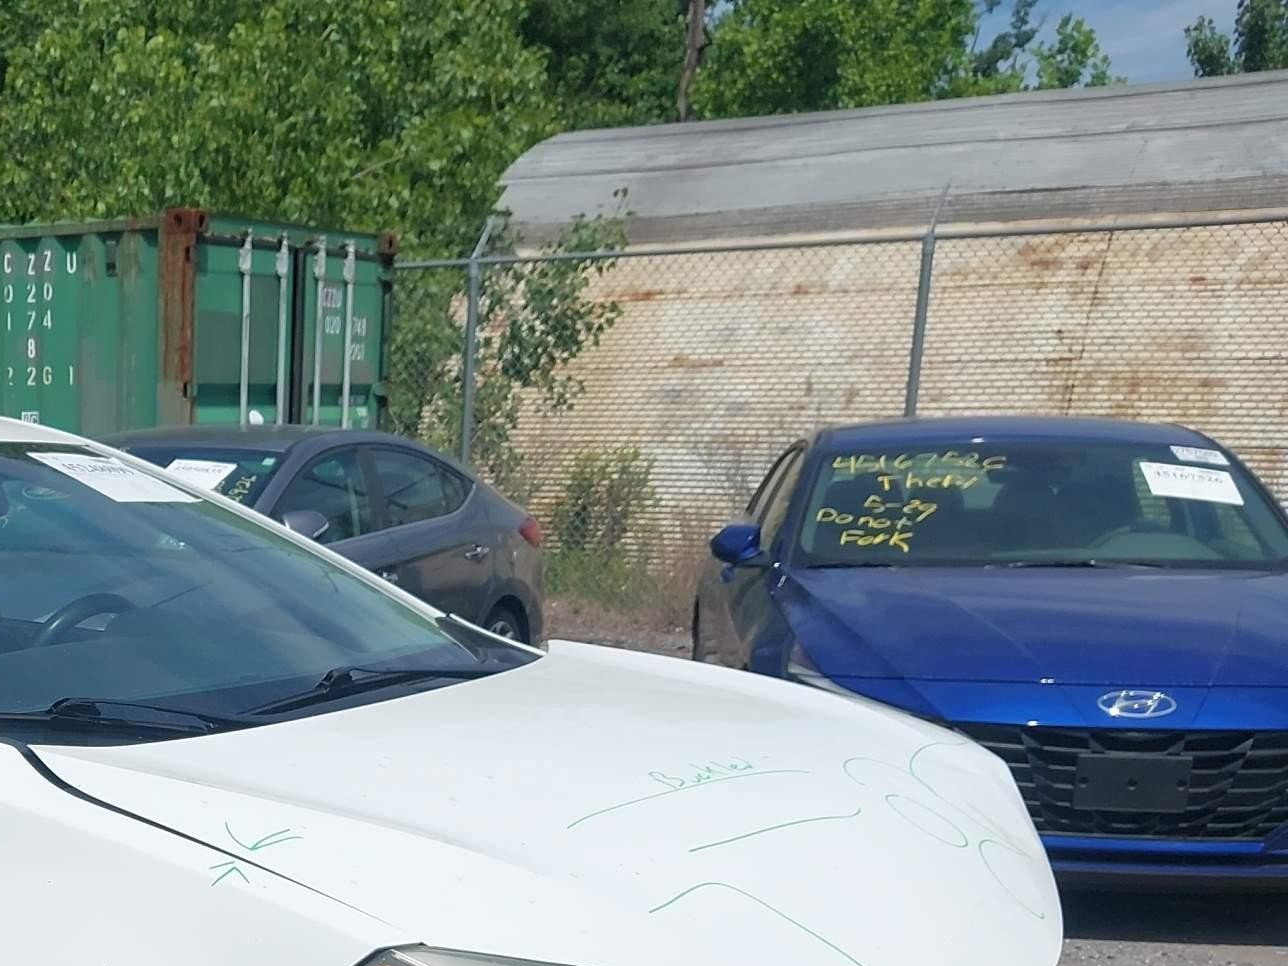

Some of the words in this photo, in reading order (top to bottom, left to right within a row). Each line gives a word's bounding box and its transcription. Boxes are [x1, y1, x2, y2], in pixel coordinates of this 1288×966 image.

[3, 250, 77, 275] CZZU
[4, 282, 53, 303] 020
[27, 338, 37, 358] 8
